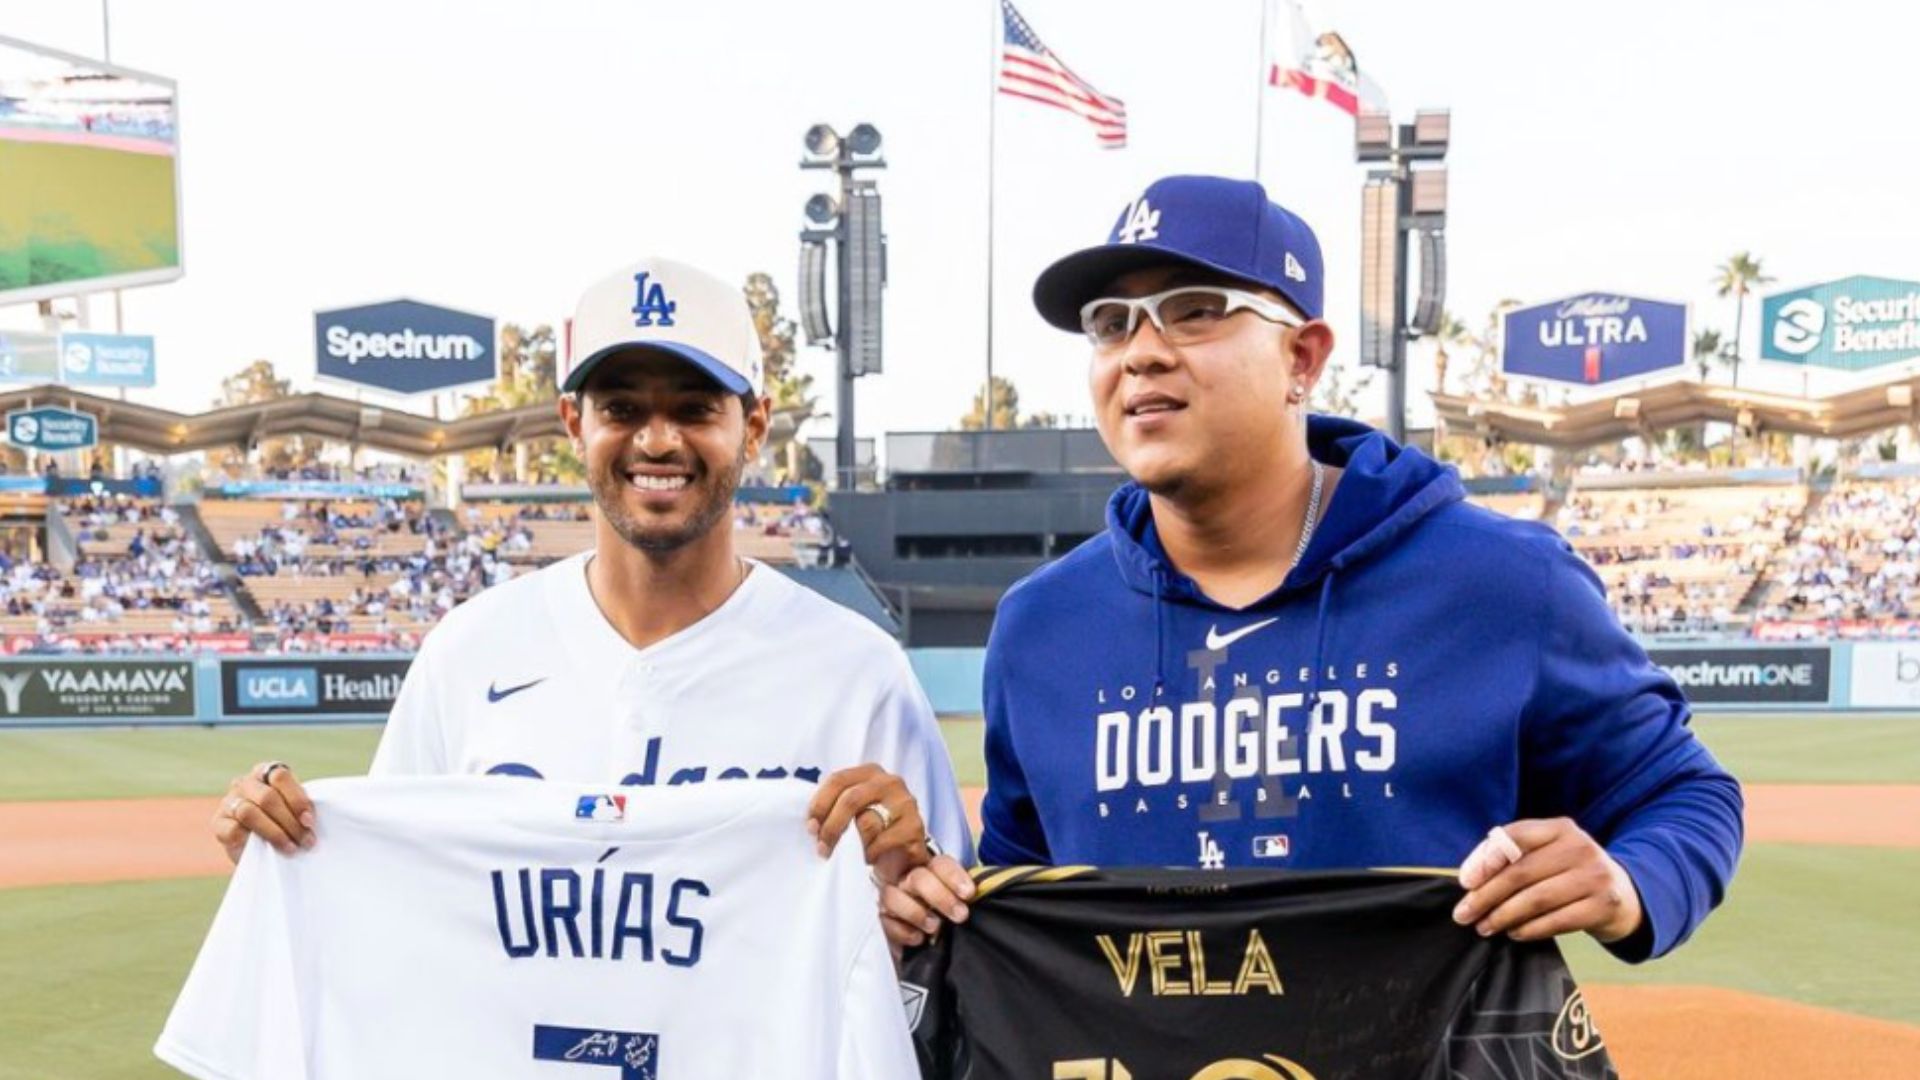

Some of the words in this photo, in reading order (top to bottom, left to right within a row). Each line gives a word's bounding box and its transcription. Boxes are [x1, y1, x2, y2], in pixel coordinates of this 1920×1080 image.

[1118, 199, 1161, 244] LA
[632, 271, 676, 327] LA
[326, 325, 476, 365] Spectrum
[1539, 315, 1648, 347] ULTRA
[248, 677, 308, 699] UCLA
[1203, 662, 1398, 690] ANGELES
[1095, 688, 1398, 793] DODGERS
[1098, 783, 1395, 817] BASEBALL
[1198, 831, 1225, 869] LA
[491, 847, 711, 968] URÍAS
[1096, 929, 1285, 998] VELA
